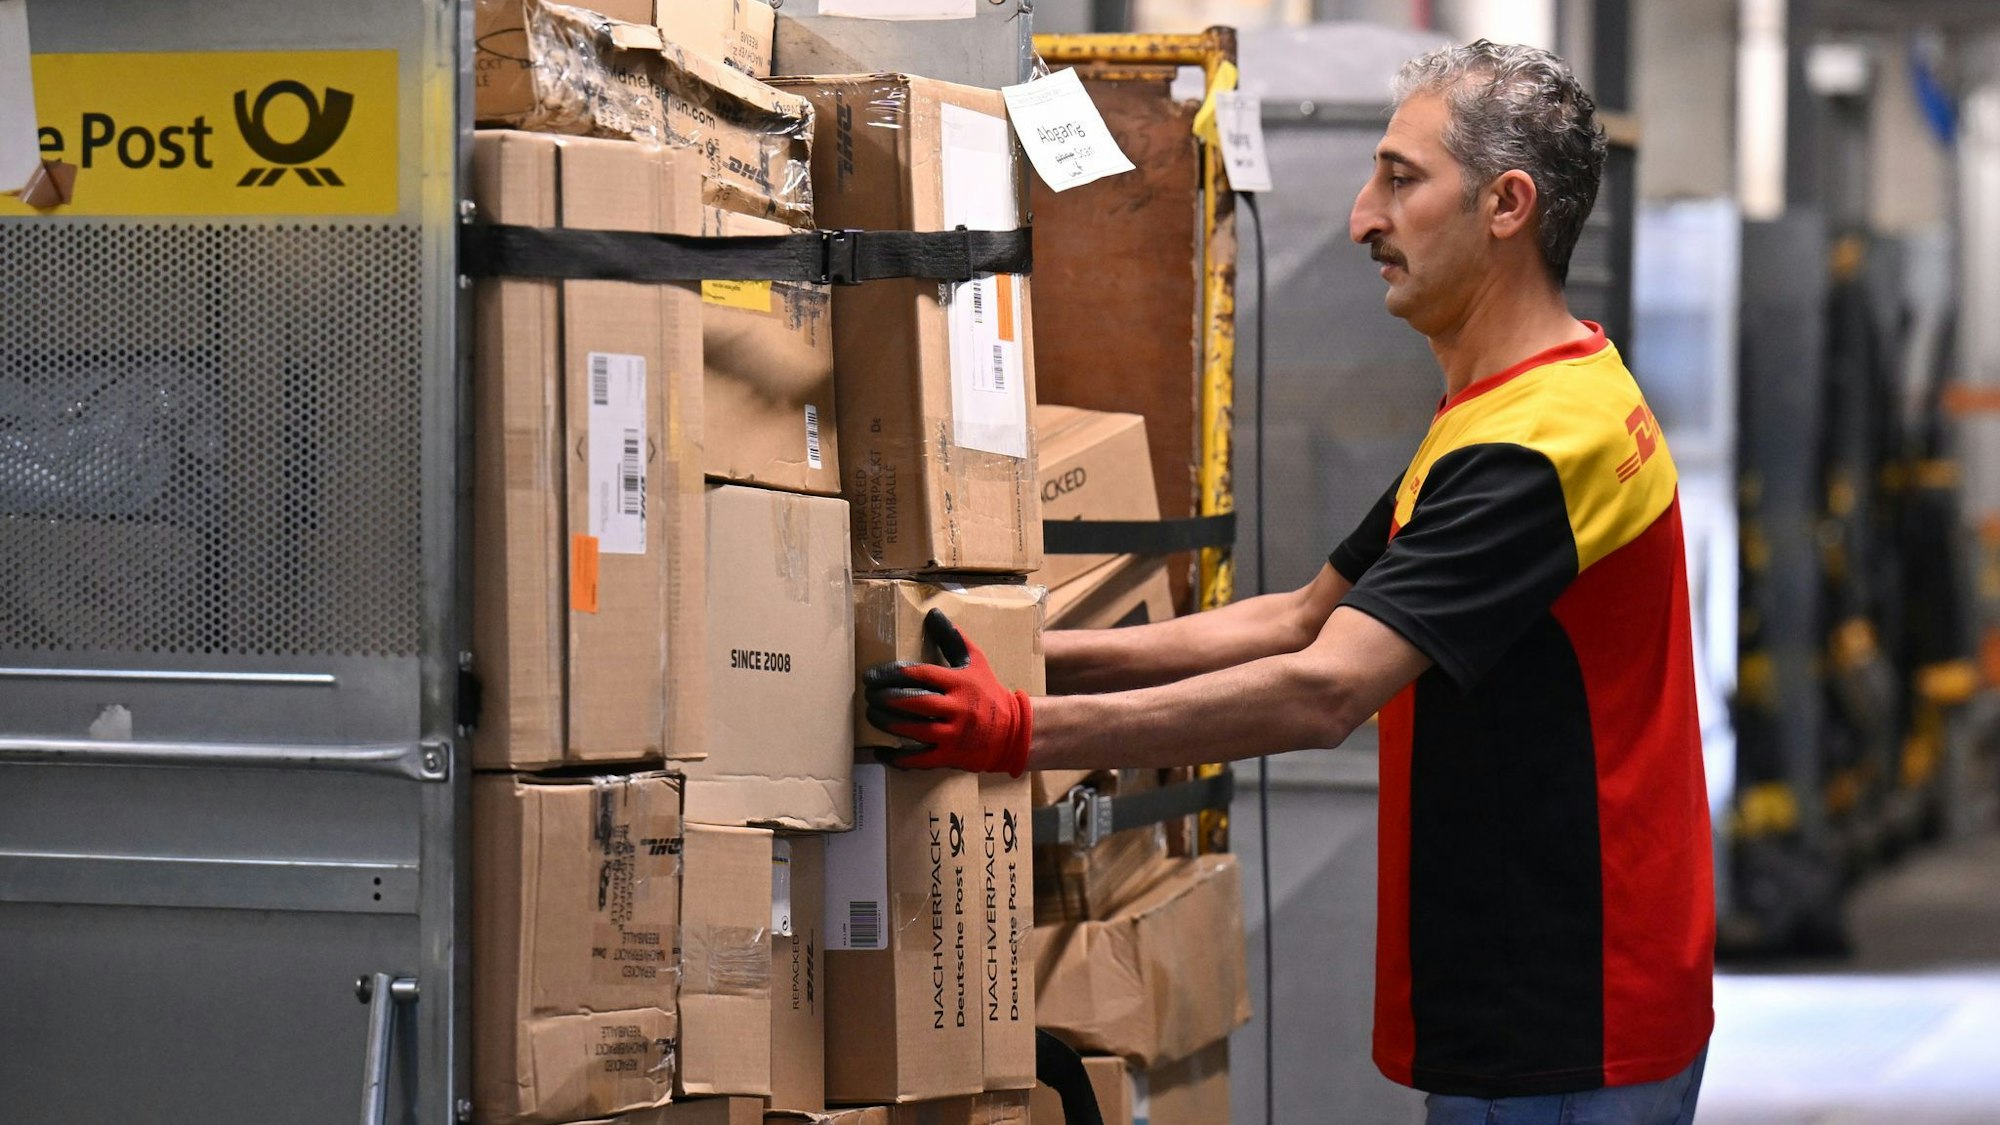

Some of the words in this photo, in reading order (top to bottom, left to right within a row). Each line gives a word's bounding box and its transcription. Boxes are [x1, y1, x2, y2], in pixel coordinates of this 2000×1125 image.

[82, 112, 213, 169] Post
[835, 103, 853, 180] DHL
[1036, 121, 1086, 144] Abgang
[1074, 146, 1096, 158] Scan
[871, 450, 884, 560] NACHVERPACKT
[731, 649, 762, 670] SINCE
[764, 653, 791, 673] 2008
[929, 811, 944, 1029] NACHVERPACKT
[955, 866, 964, 915] Post
[984, 806, 999, 1021] NACHVERPACKT
[1008, 862, 1017, 910] Post
[792, 934, 800, 1010] REPACKED
[955, 921, 965, 1027] Deutsche
[1008, 917, 1018, 1021] Deutsche
